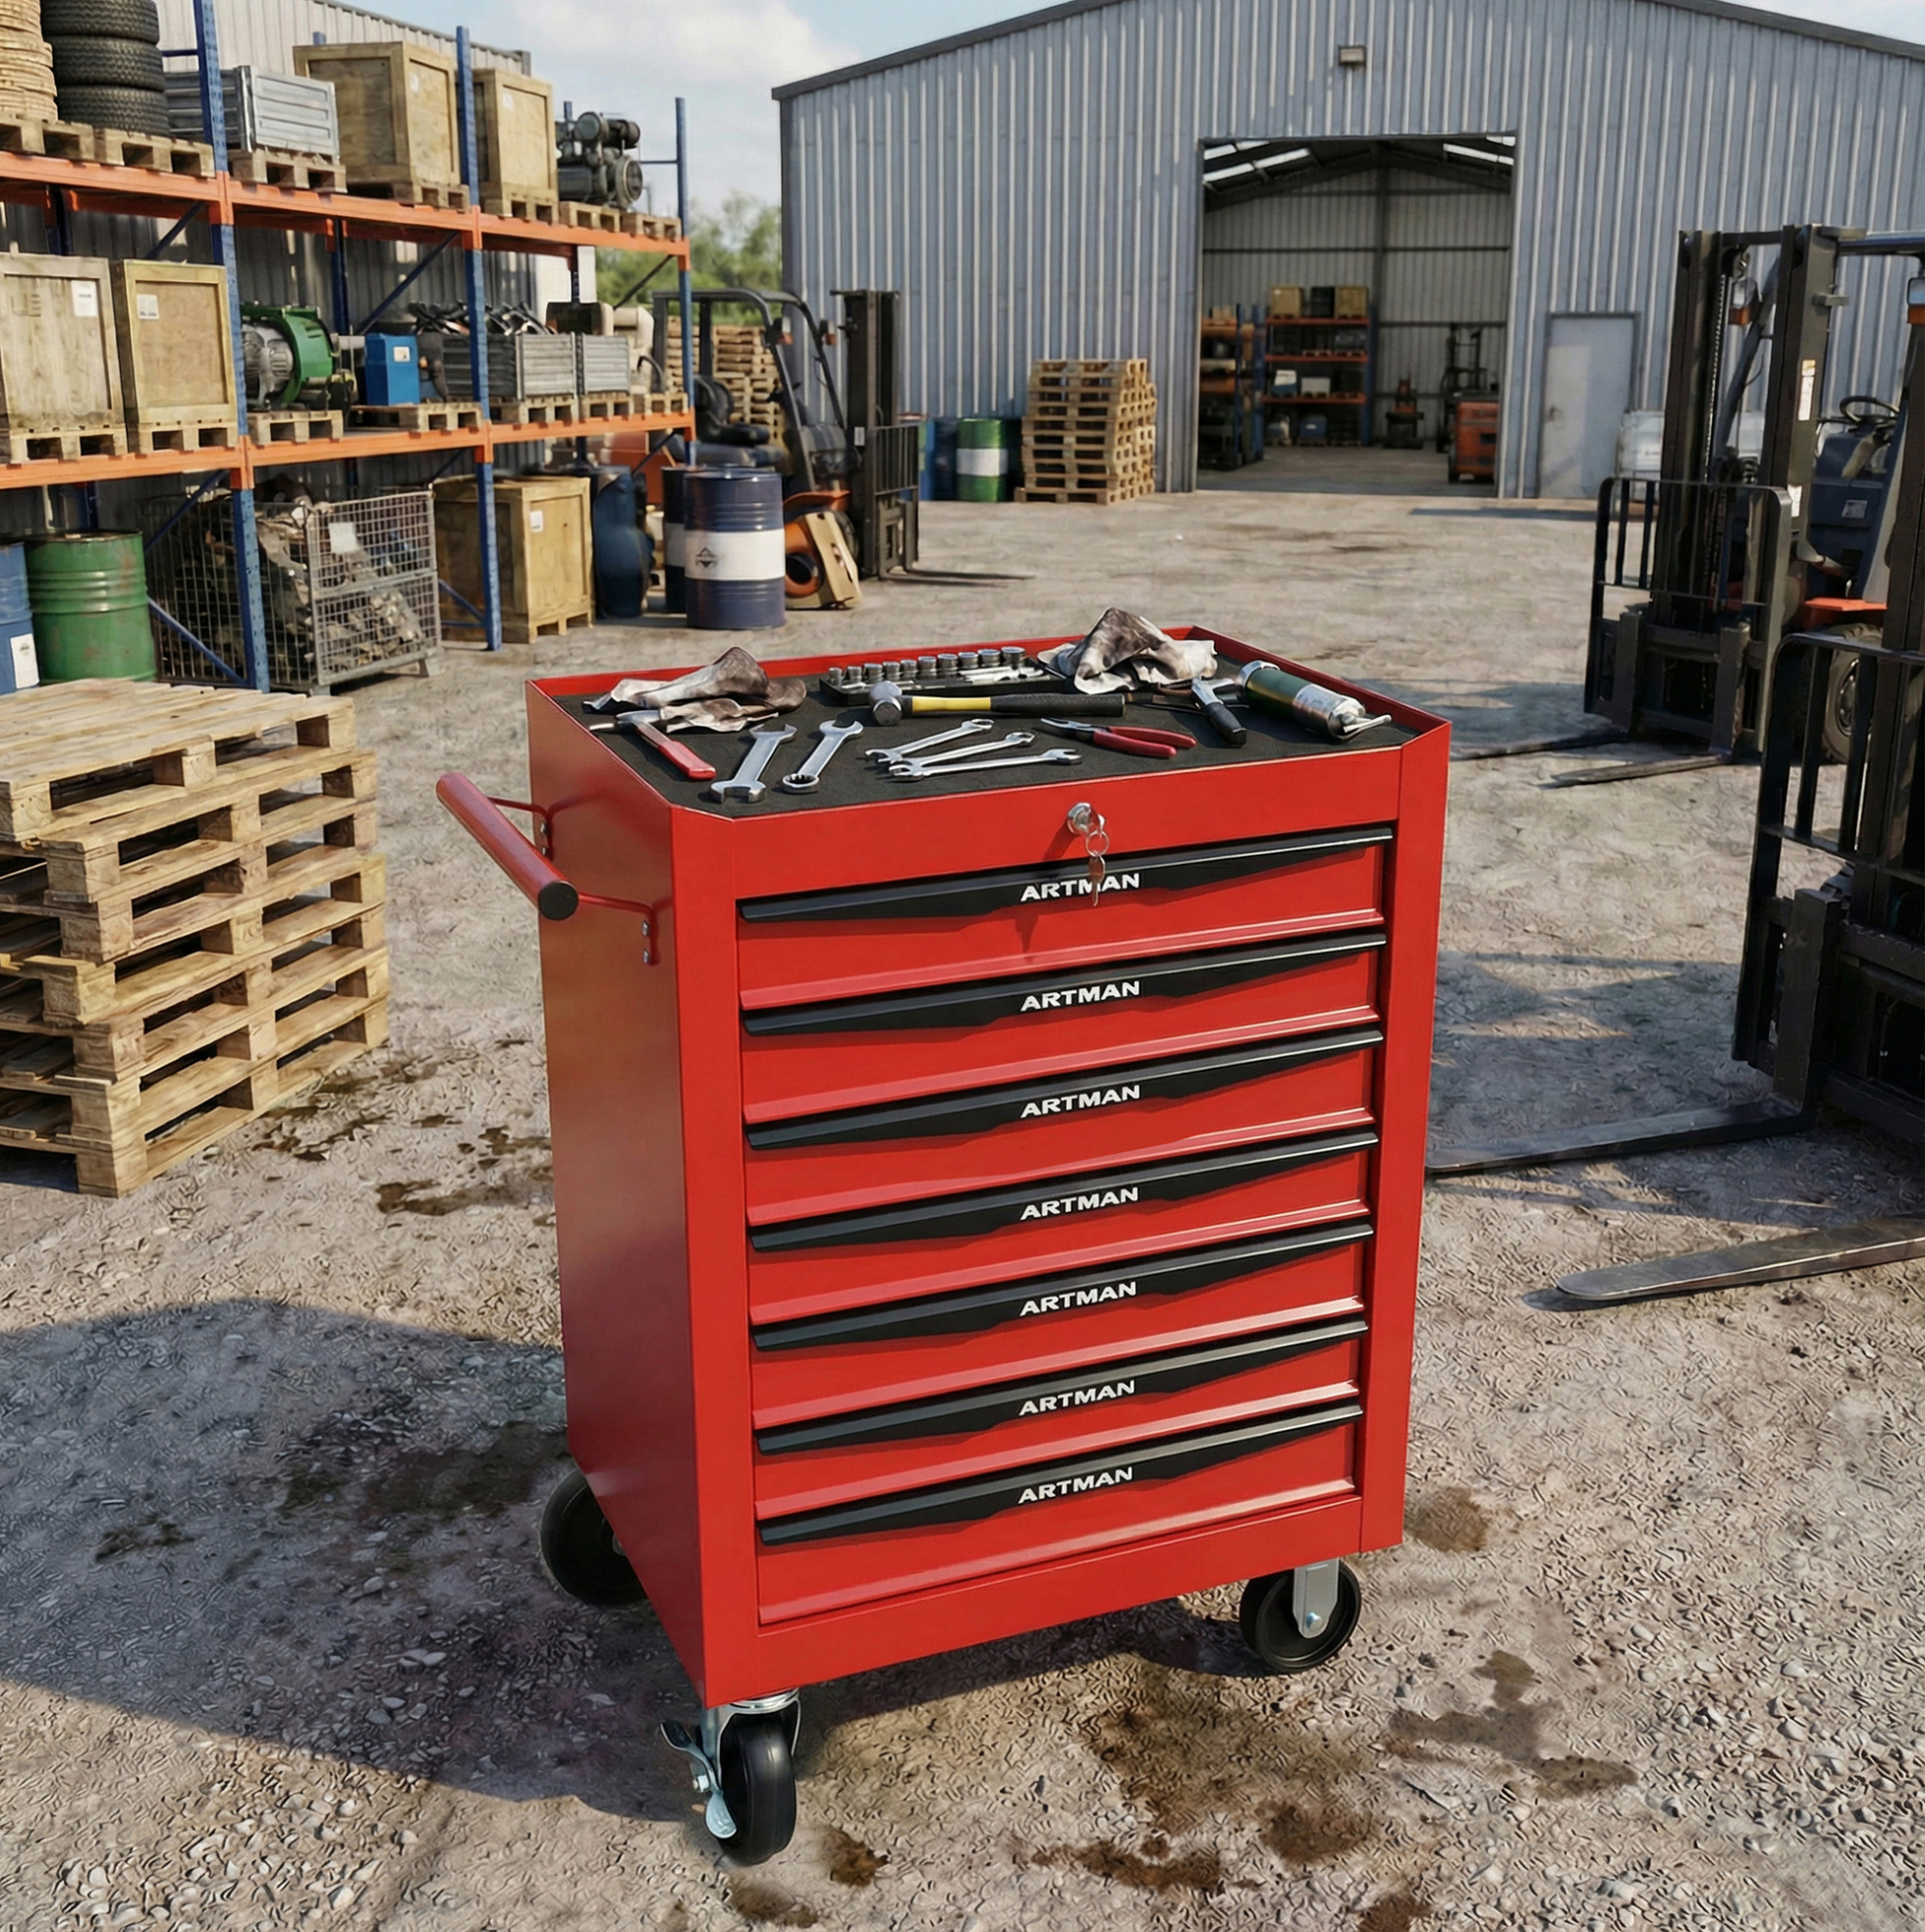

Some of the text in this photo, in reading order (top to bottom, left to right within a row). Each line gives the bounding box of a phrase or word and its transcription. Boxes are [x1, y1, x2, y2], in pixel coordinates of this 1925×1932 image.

[1020, 980, 1140, 1012] ARTMAN
[1020, 1084, 1140, 1118] ARTMAN
[1019, 1187, 1138, 1220] ARTMAN
[1019, 1281, 1137, 1316] ARTMAN
[1018, 1380, 1135, 1415] ARTMAN
[1018, 1466, 1133, 1504] ARTMAN
